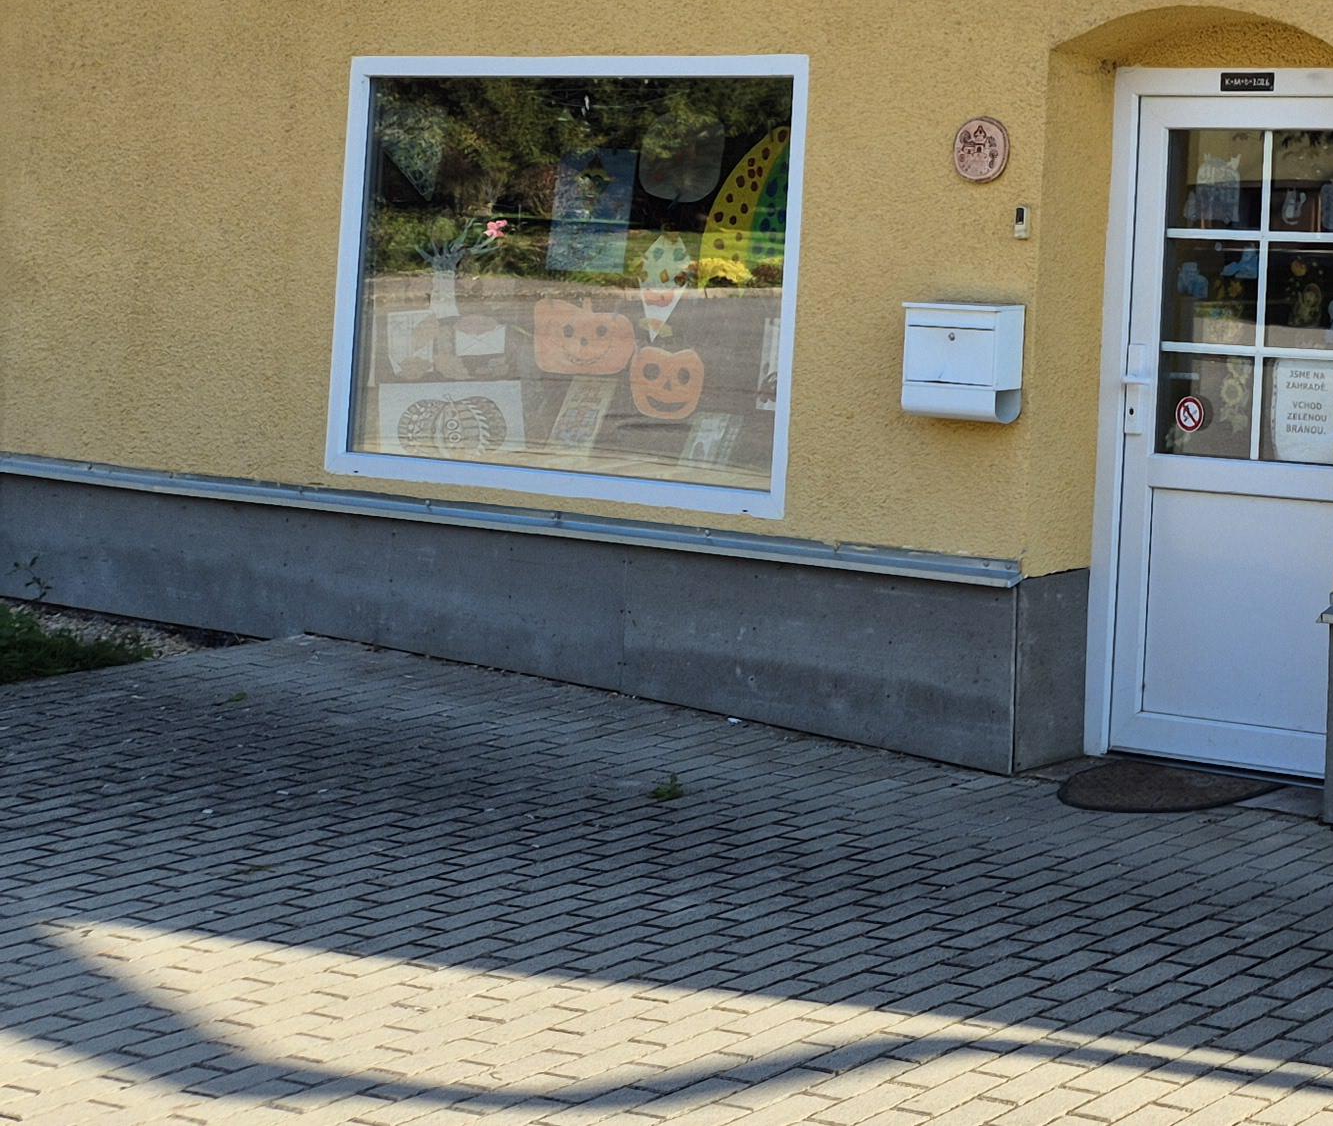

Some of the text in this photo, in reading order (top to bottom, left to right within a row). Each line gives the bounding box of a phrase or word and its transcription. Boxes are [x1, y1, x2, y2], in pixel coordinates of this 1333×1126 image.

[1290, 370, 1325, 380] JSME NA
[1292, 401, 1322, 410] VCHOD
[1287, 412, 1327, 422] ZELENOU
[1286, 424, 1326, 434] BRANOU.
